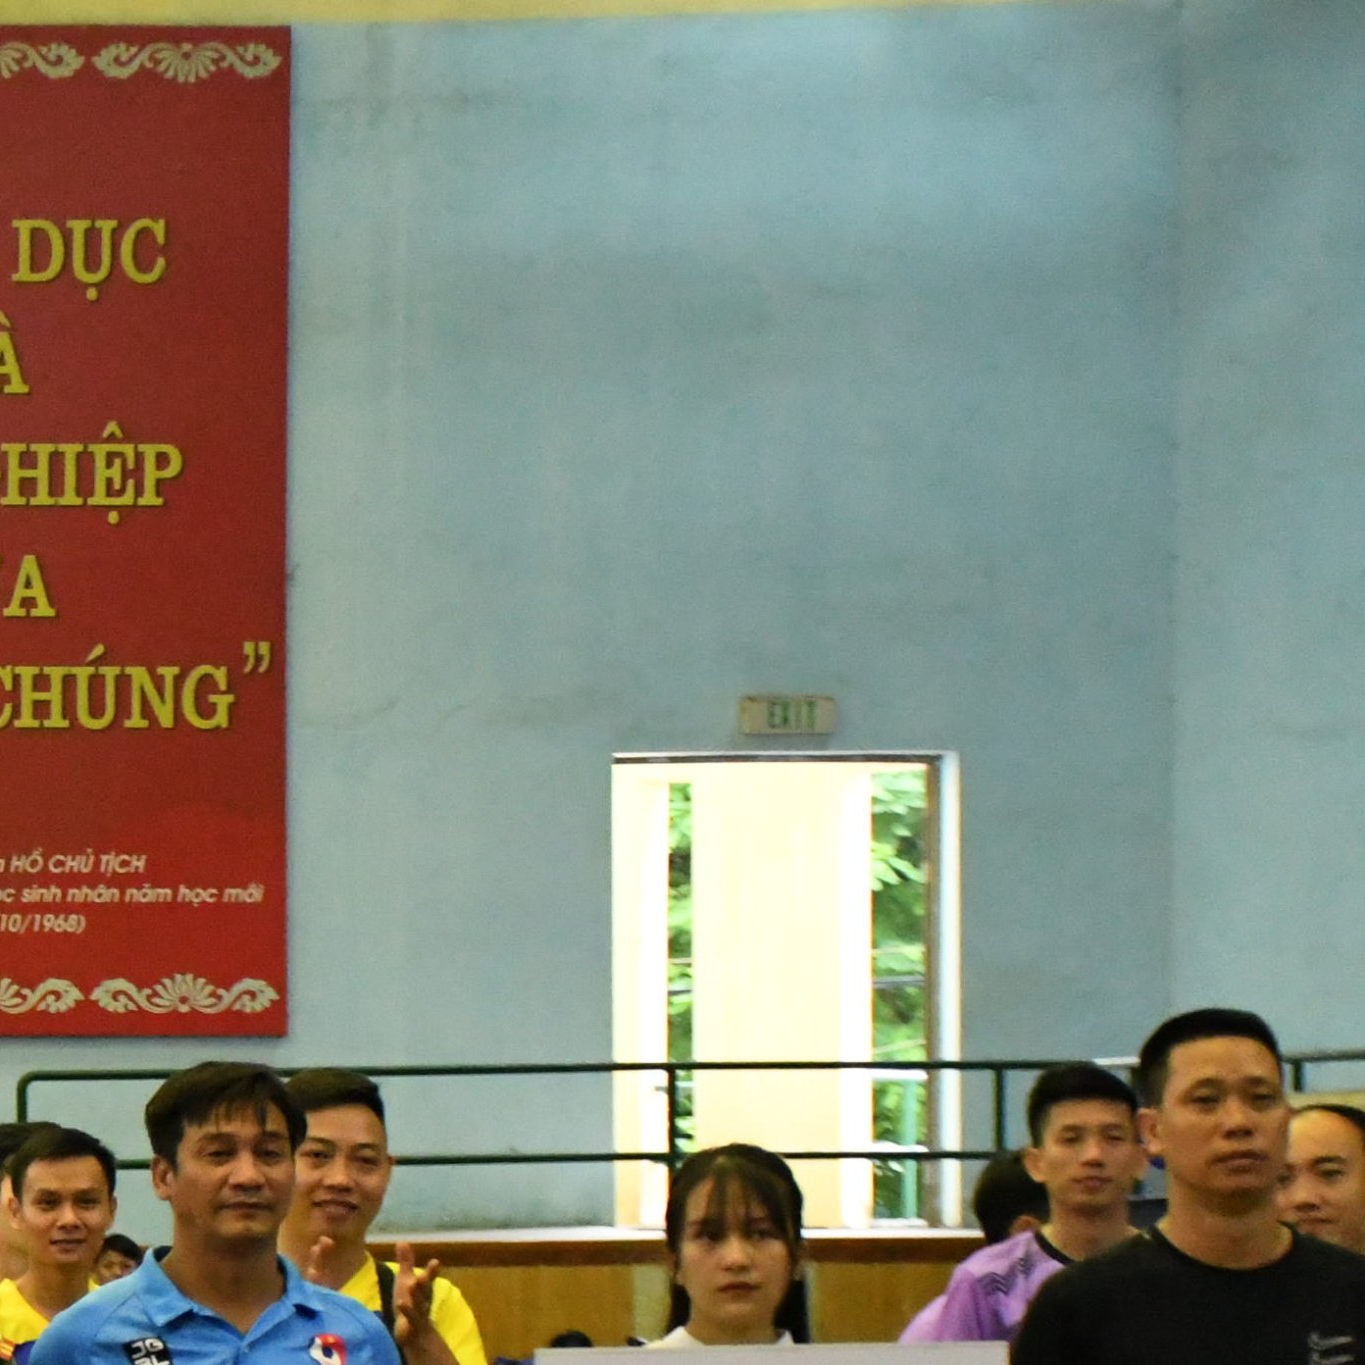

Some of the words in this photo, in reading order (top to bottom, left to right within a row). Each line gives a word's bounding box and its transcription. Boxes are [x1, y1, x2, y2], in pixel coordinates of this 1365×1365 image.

[11, 218, 167, 301] DỤC
[10, 847, 44, 873] HỒ
[49, 848, 95, 873] CHỦ
[100, 853, 147, 877] TỊCH
[21, 884, 62, 903] sinh
[124, 883, 173, 903] năm
[177, 884, 219, 907] học
